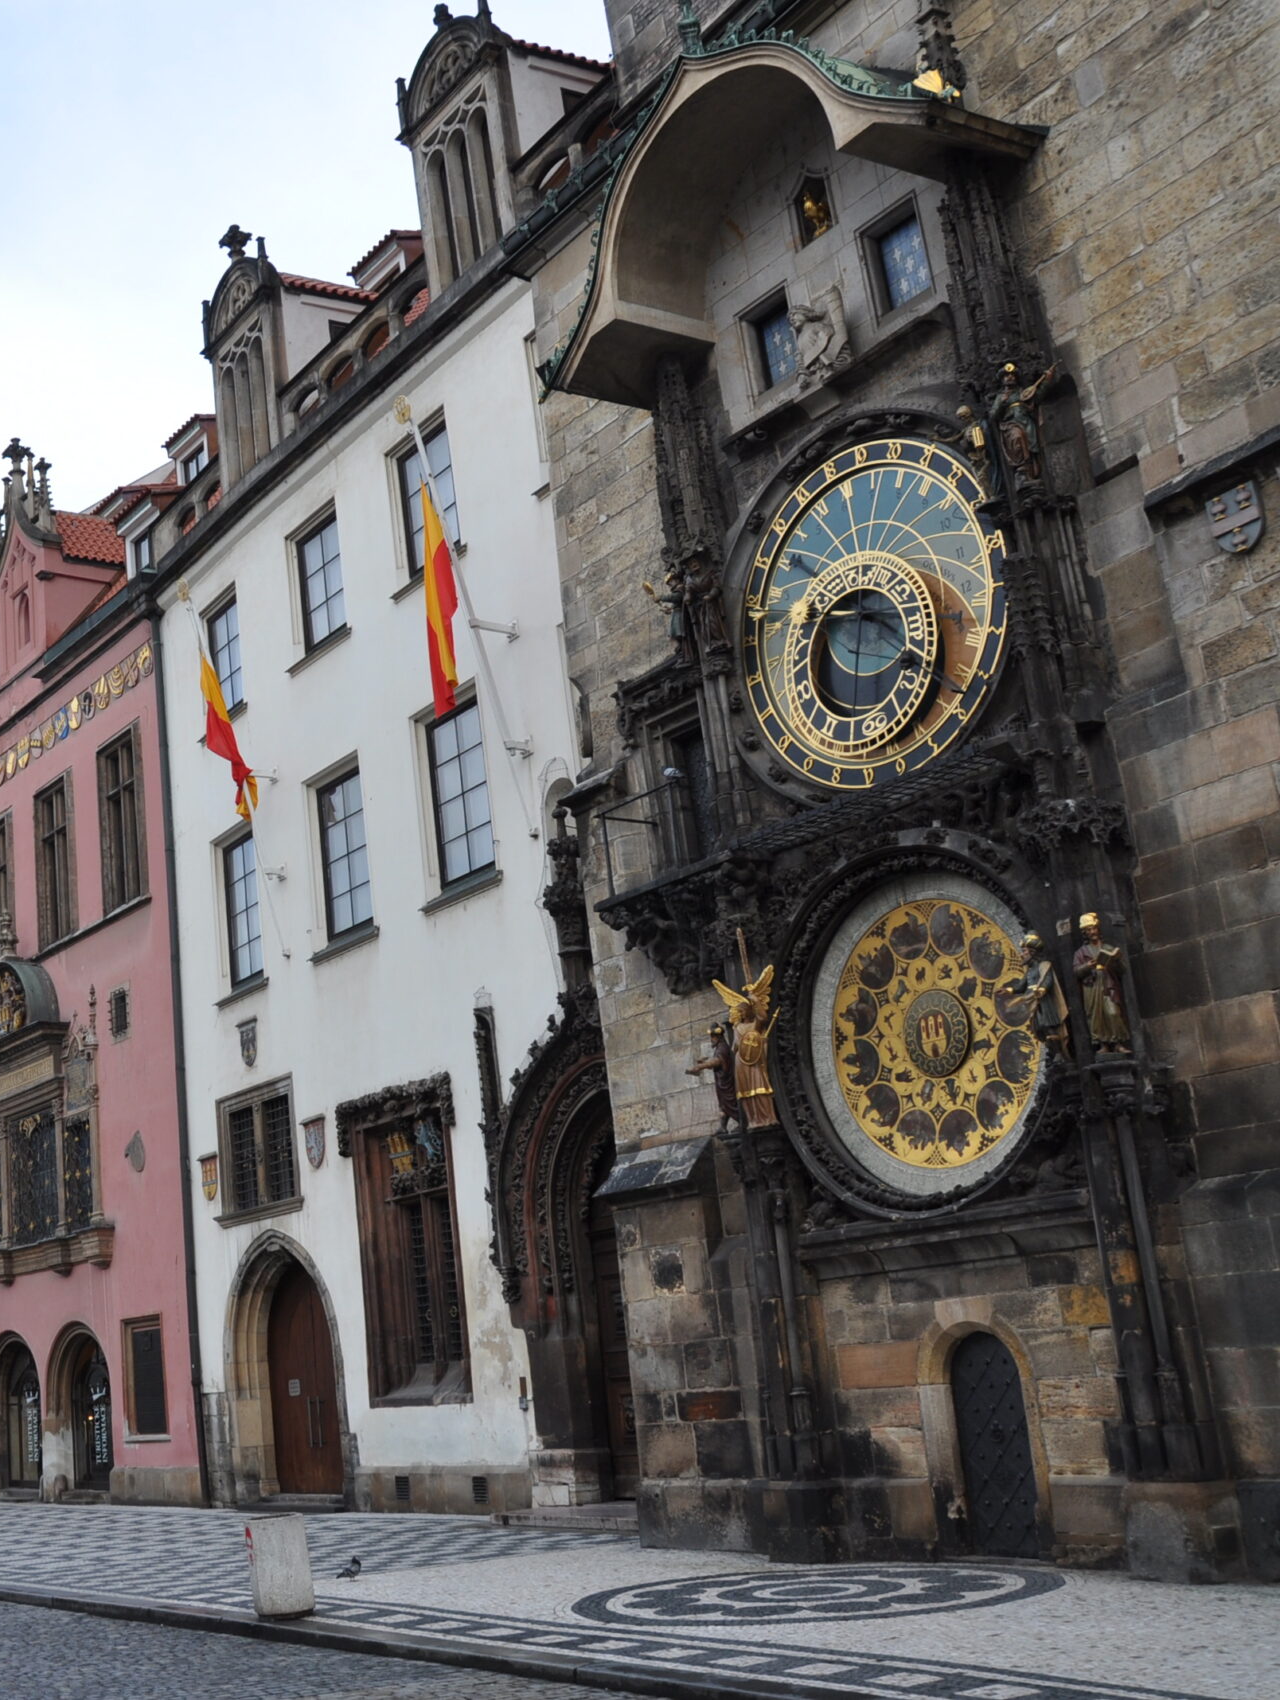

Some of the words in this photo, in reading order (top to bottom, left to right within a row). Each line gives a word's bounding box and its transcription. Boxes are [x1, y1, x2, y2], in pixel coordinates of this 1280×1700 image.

[939, 516, 951, 532] 10
[956, 545, 966, 560] 11
[960, 579, 972, 594] 12
